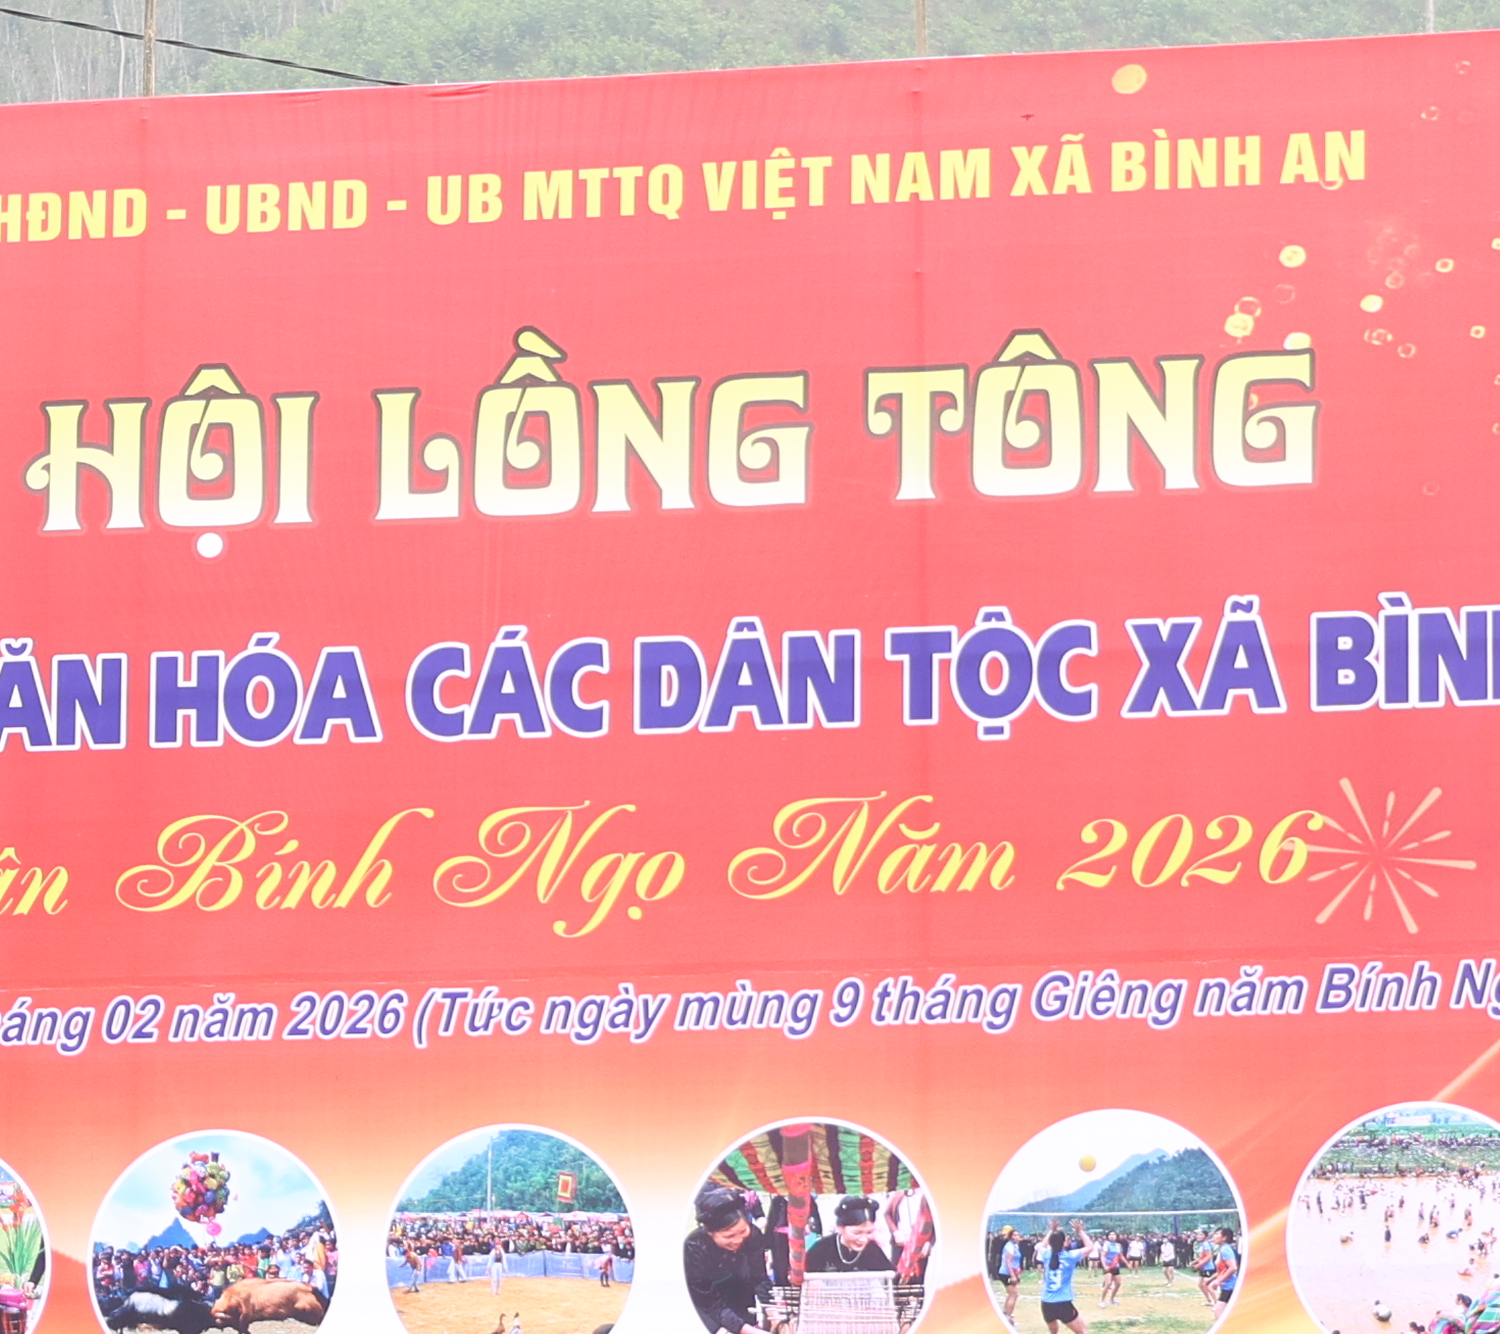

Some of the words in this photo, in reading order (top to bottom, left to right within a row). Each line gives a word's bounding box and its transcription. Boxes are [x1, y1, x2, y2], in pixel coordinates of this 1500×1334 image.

[205, 179, 368, 235] UBND
[426, 173, 503, 225] UB
[523, 163, 684, 221] MTTQ
[701, 147, 833, 220] VIỆT
[850, 147, 991, 205] NAM
[1010, 133, 1093, 196] XÃ
[1111, 128, 1261, 192] BÌNH
[1279, 129, 1366, 184] AN
[25, 368, 315, 559] HỘI
[374, 331, 810, 520] LỒNG
[865, 330, 1317, 502] TÔNG
[151, 634, 380, 746] HÓA
[408, 627, 607, 740] CÁC
[636, 618, 859, 733] DÂN
[887, 608, 1096, 739] TỘC
[1124, 597, 1284, 716] XÃ
[115, 807, 435, 912] Bính
[430, 800, 685, 938] Ngọ
[727, 790, 1015, 900] Năm
[1056, 809, 1325, 892] 2026
[103, 996, 163, 1043] 02
[170, 995, 276, 1041] năm
[284, 991, 406, 1038] 2026
[415, 988, 533, 1047] (Tức
[542, 984, 668, 1043] ngày
[676, 981, 821, 1038] mùng
[831, 979, 863, 1025] 9
[873, 975, 1020, 1032] tháng
[1033, 971, 1185, 1028] Giêng
[1196, 968, 1306, 1015] năm
[1318, 962, 1440, 1012] Bính
